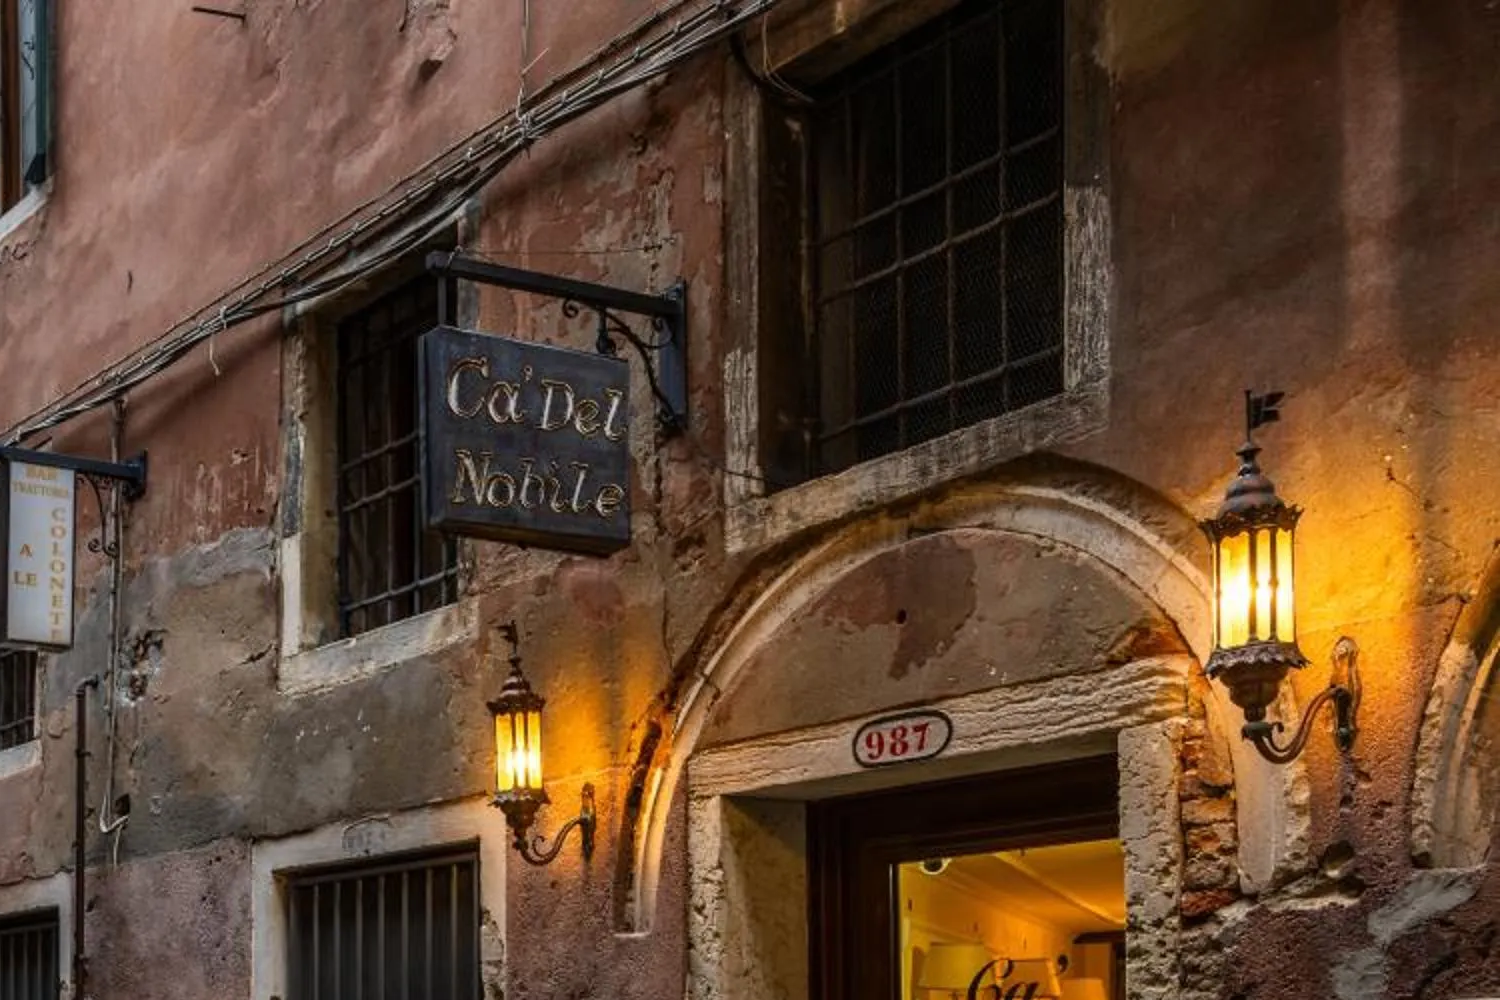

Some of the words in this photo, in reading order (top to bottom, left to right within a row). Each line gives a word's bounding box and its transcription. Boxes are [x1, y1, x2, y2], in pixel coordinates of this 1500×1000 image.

[448, 355, 532, 423] Ca'
[535, 377, 628, 440] Del
[451, 449, 625, 517] Nobile
[13, 571, 37, 587] LE
[865, 722, 930, 760] 987
